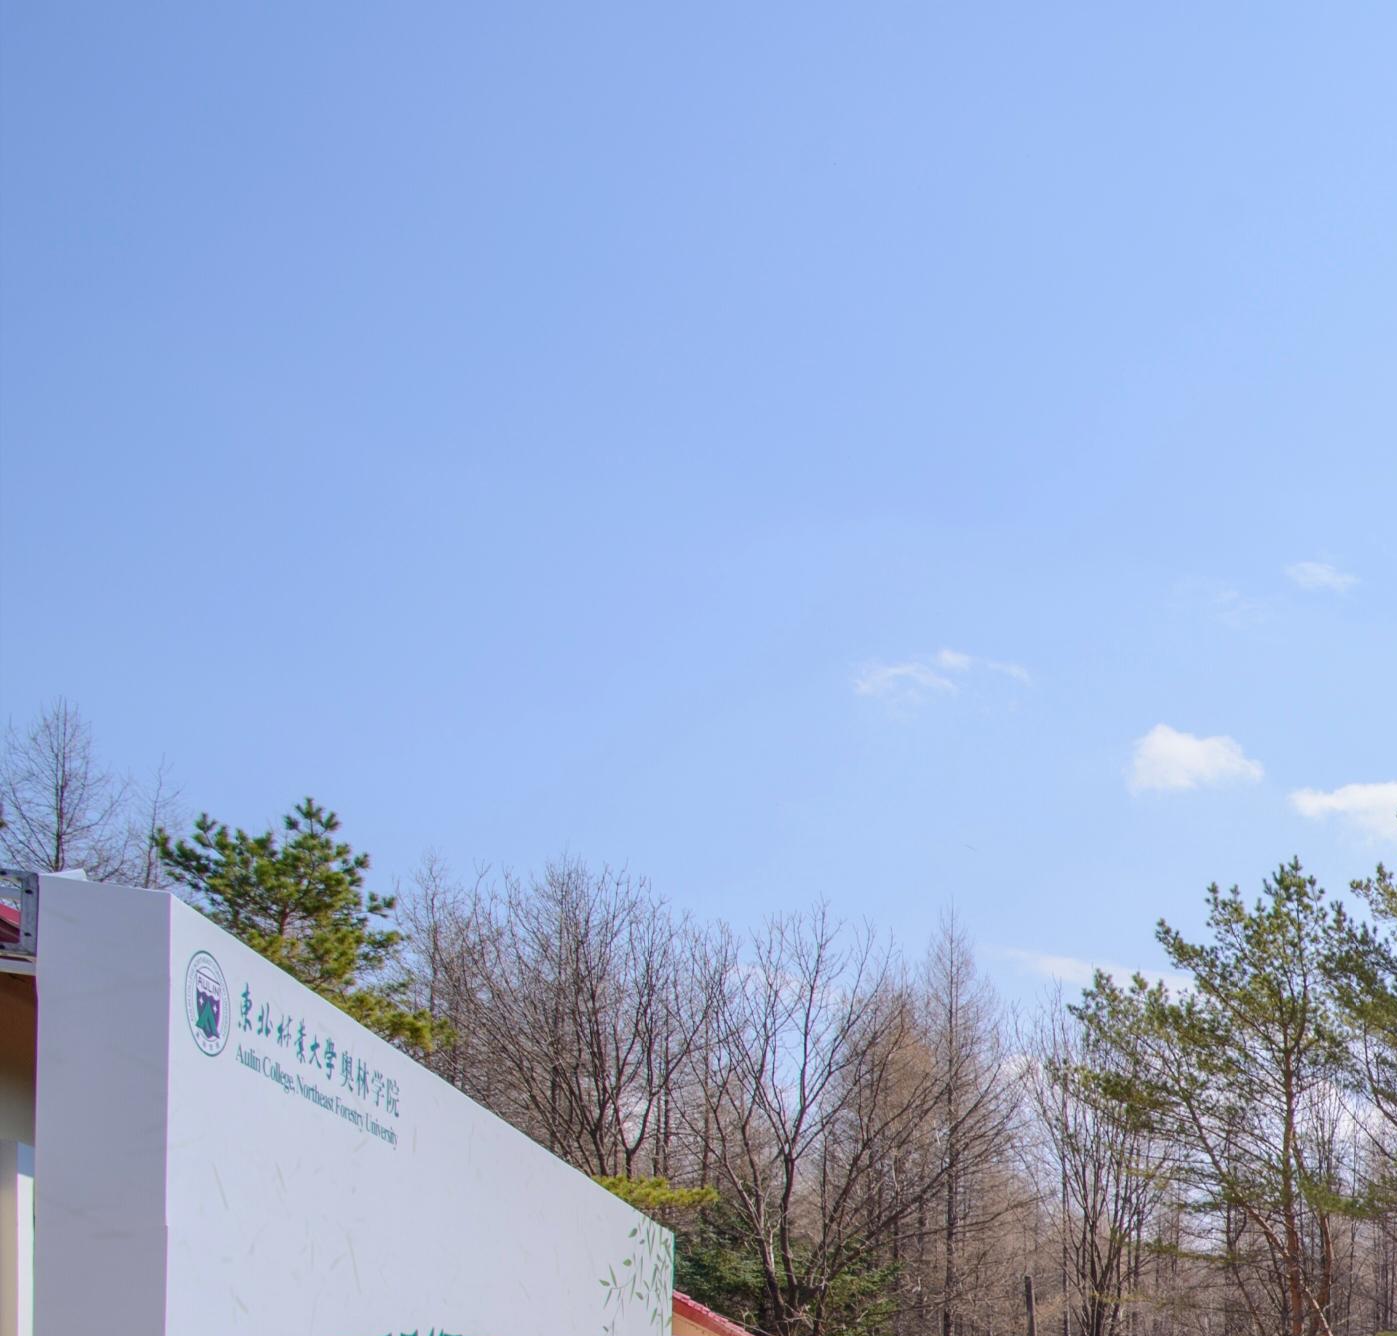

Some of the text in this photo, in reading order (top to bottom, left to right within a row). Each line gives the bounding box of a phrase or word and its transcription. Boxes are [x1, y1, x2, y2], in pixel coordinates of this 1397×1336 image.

[235, 1044, 261, 1078] Aulin
[296, 1074, 334, 1114] Northeast
[335, 1096, 364, 1132] Forestry
[365, 1113, 399, 1150] University
